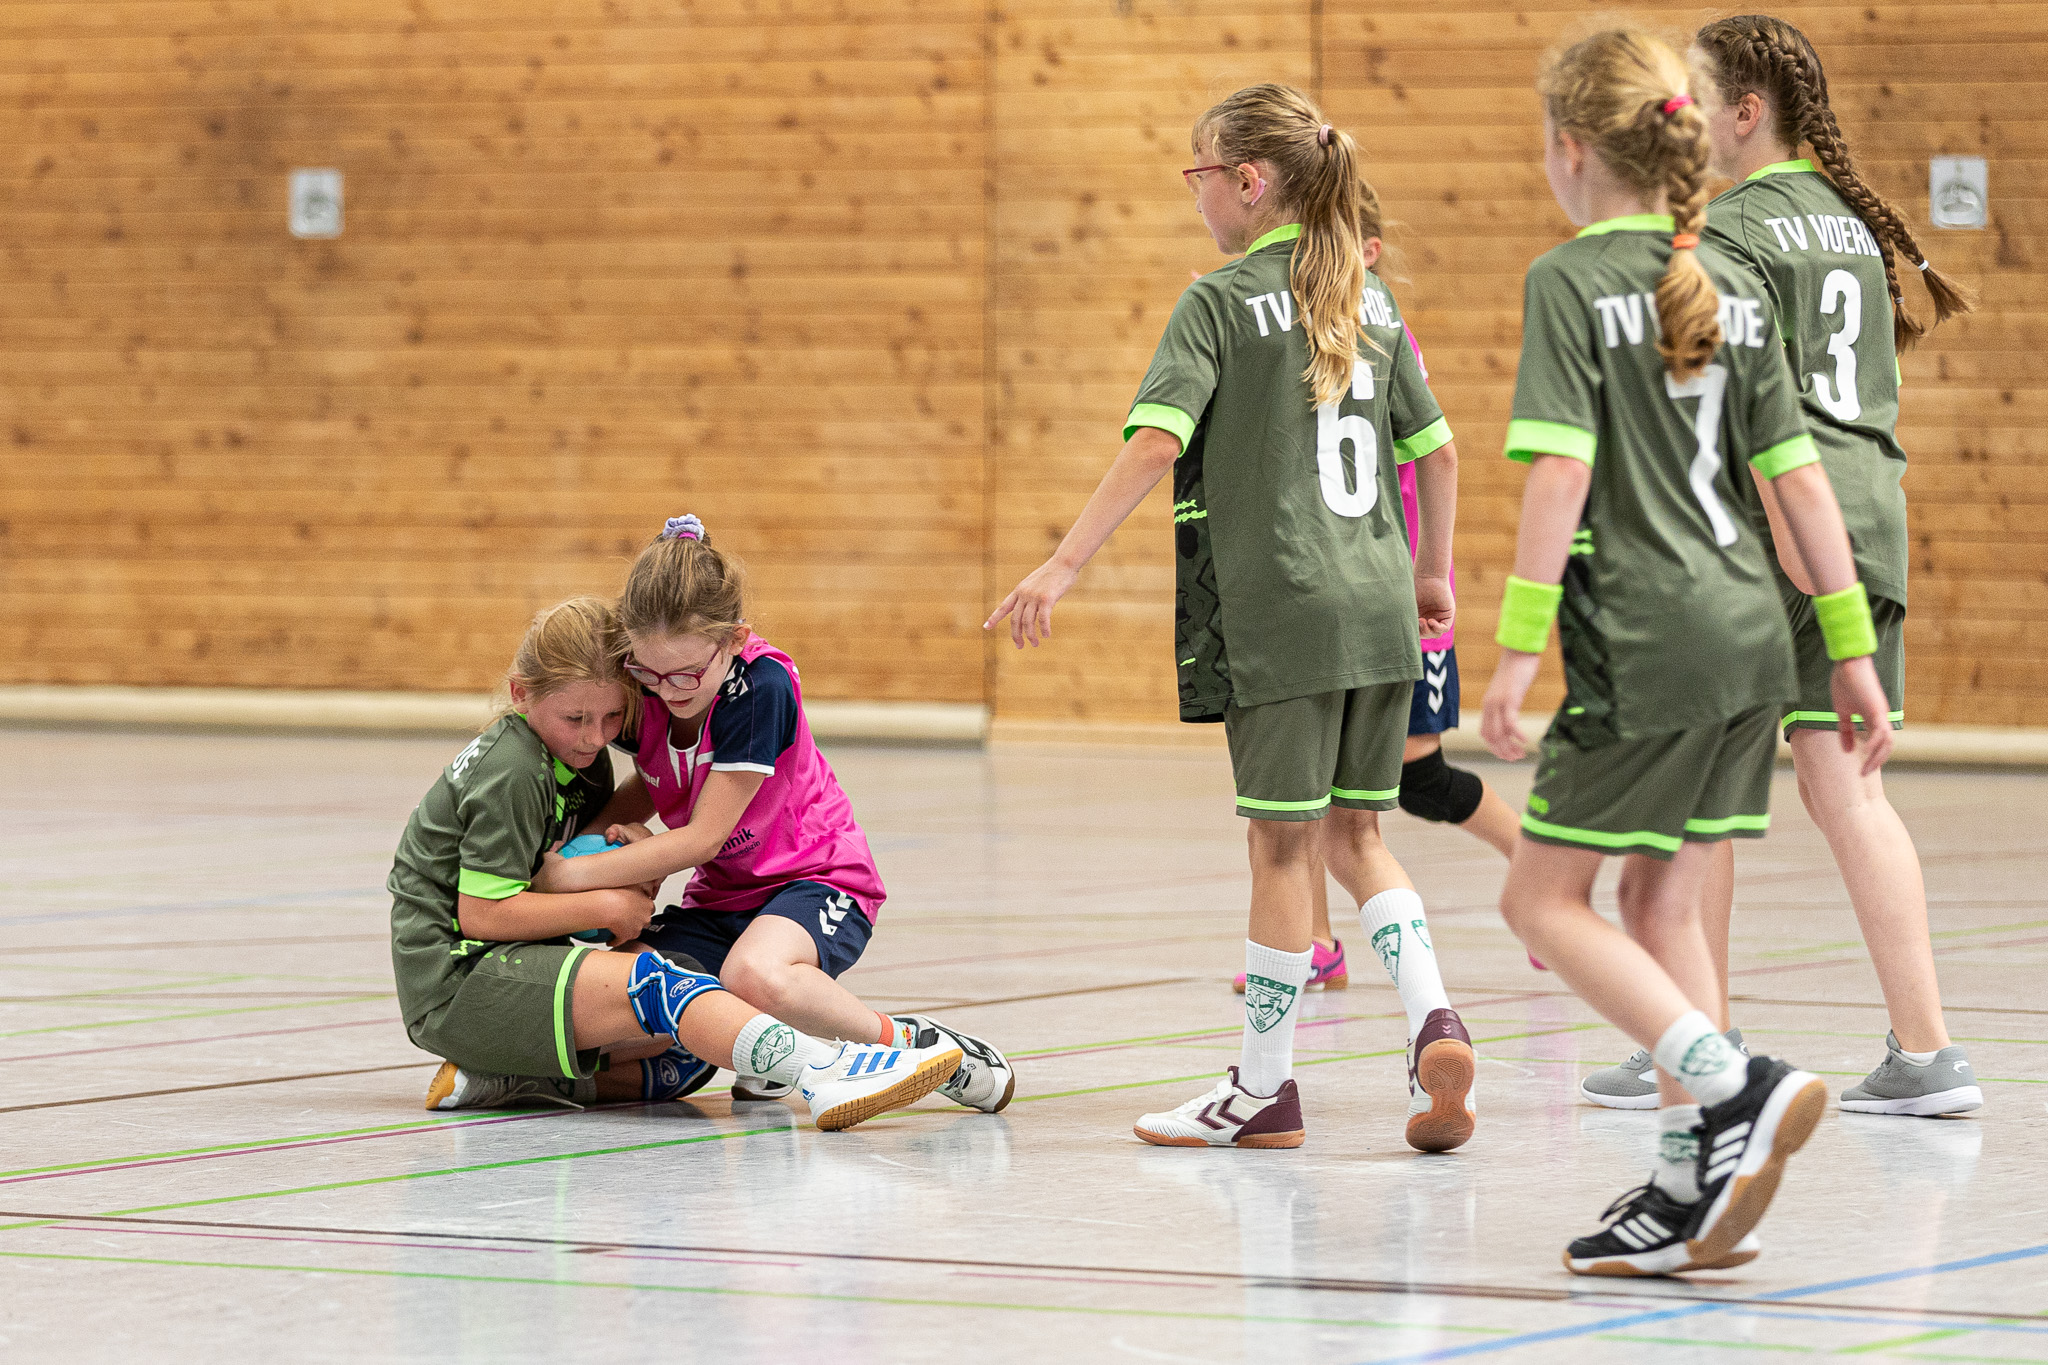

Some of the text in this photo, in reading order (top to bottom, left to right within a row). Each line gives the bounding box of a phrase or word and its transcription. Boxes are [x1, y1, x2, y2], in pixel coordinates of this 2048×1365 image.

[1764, 213, 1882, 257] TV VOERD
[1244, 290, 1293, 338] TV
[1593, 293, 1645, 349] TV
[1812, 269, 1862, 422] 3
[1315, 358, 1379, 519] 6
[1664, 363, 1739, 548] 7
